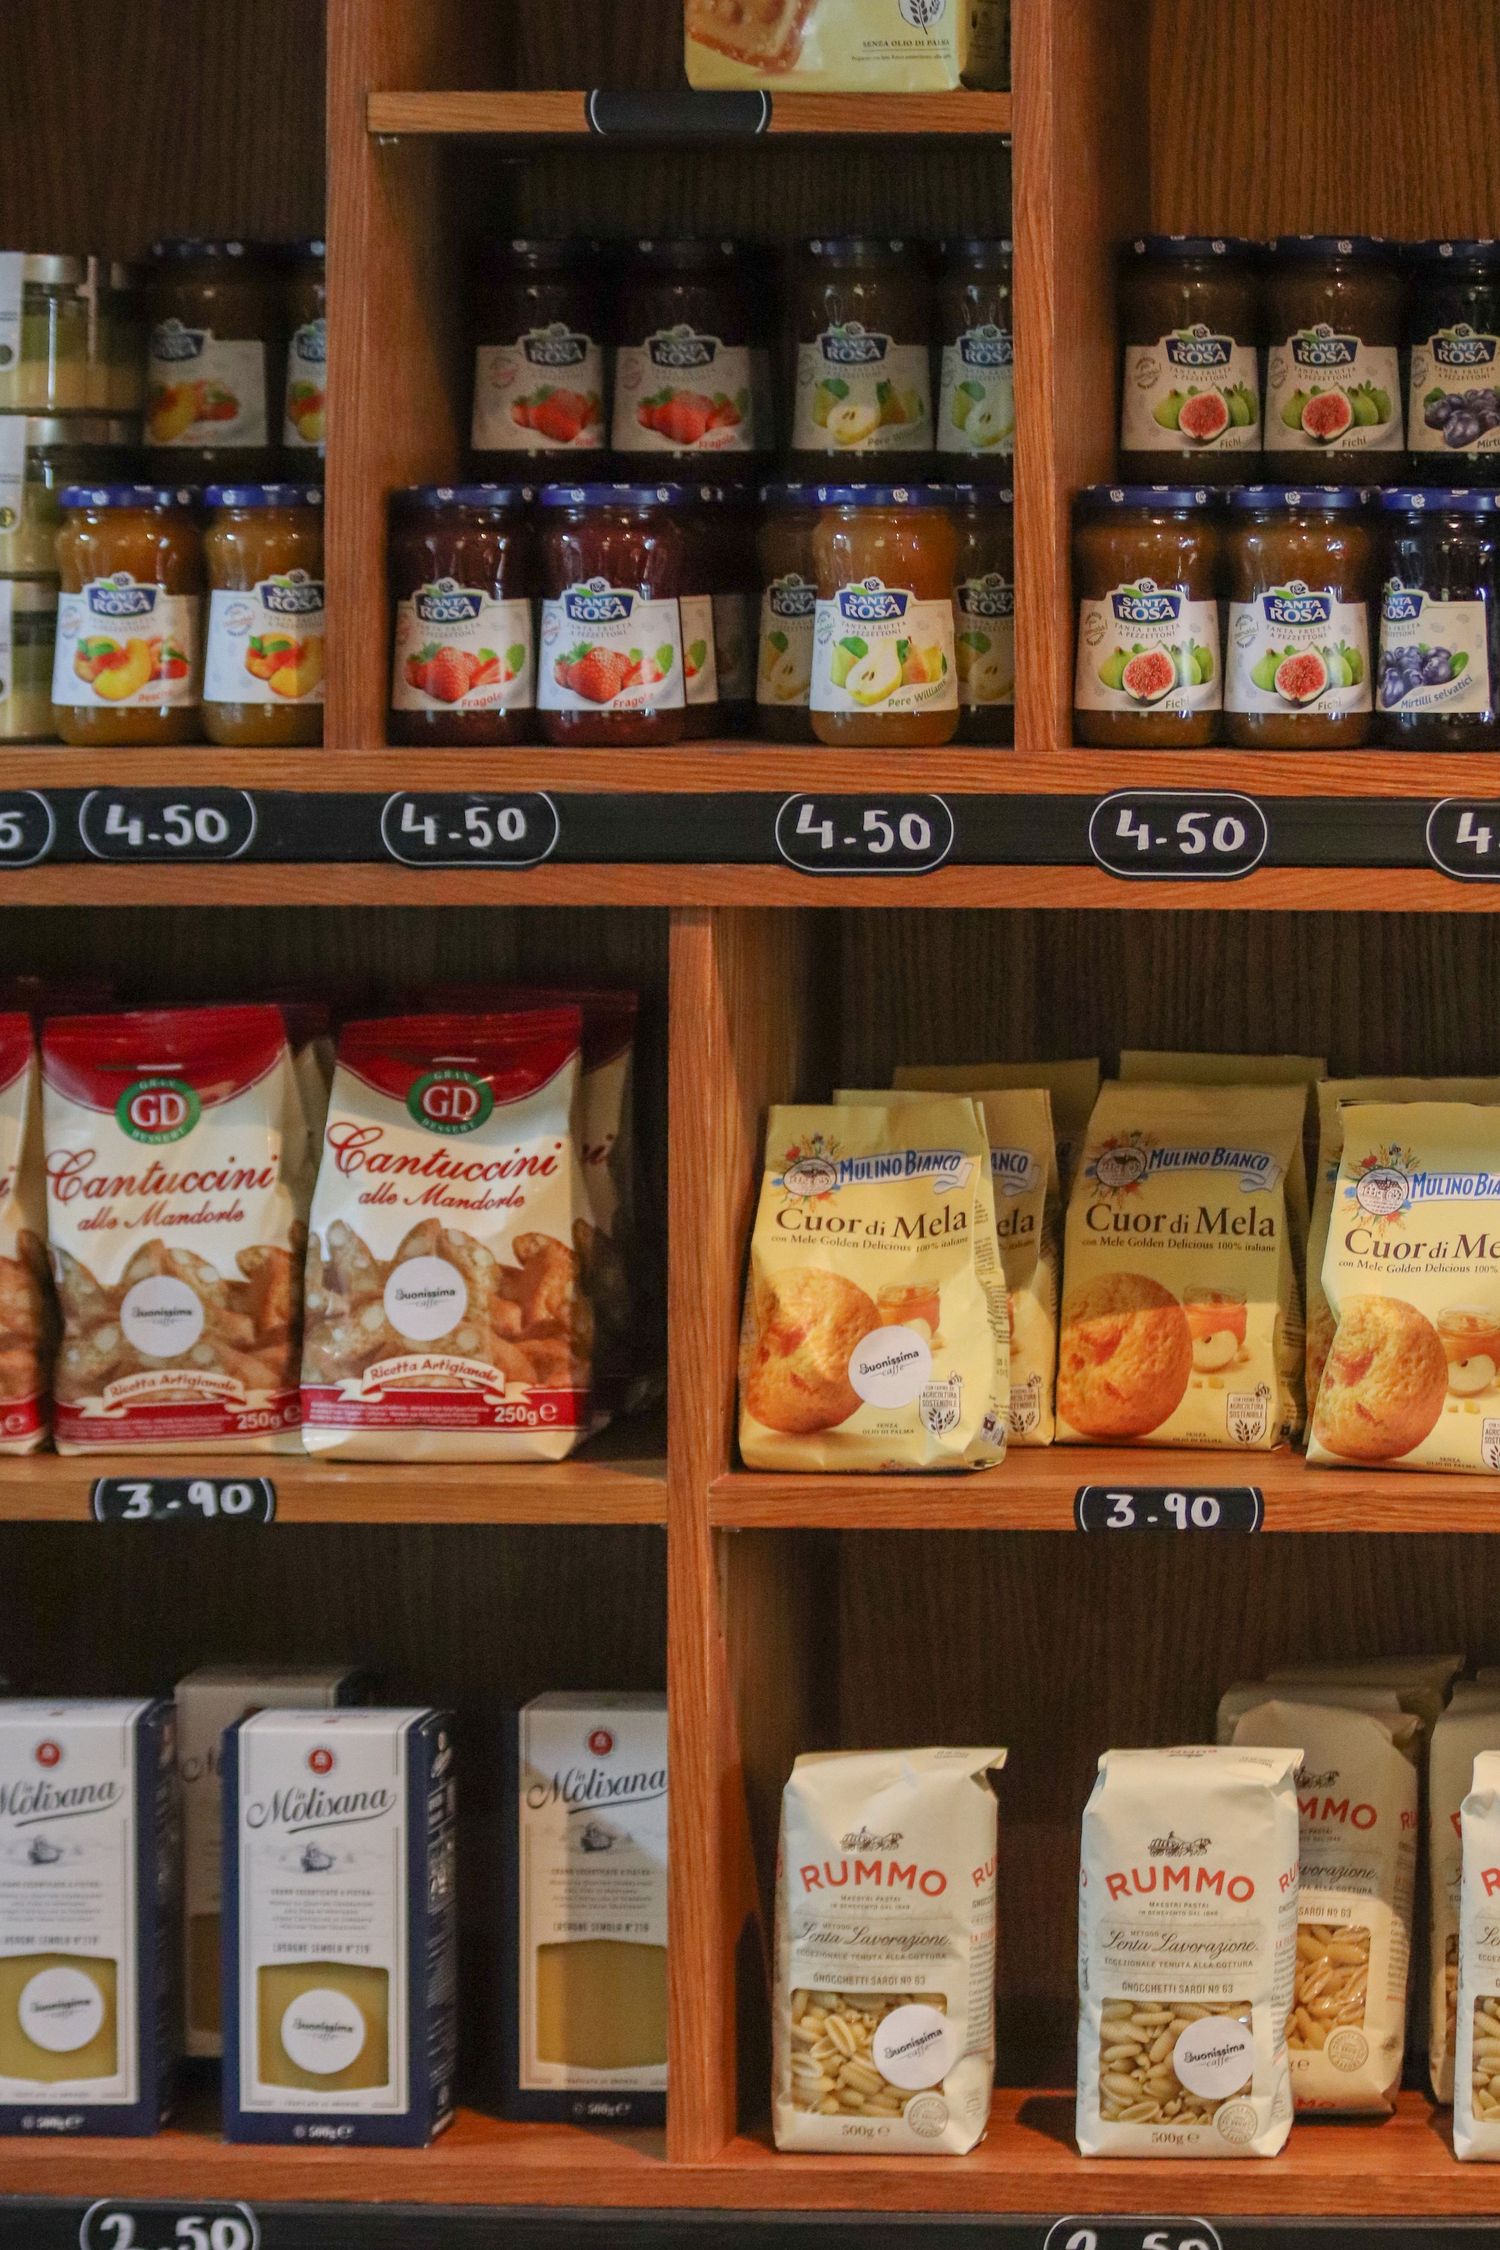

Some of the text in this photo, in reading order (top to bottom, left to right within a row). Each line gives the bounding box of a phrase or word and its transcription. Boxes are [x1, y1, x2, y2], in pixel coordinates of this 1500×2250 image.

[1177, 342, 1222, 351] SANTA
[1302, 341, 1347, 351] SANTA
[1441, 340, 1484, 350] SANTA
[826, 348, 882, 361] ROSA
[1172, 350, 1228, 364] ROSA
[1298, 350, 1351, 364] ROSA
[1438, 350, 1490, 364] ROSA
[1220, 436, 1242, 449] Fichi
[1342, 436, 1366, 448] Fichi
[98, 588, 144, 600] SANTA
[274, 587, 319, 598] SANTA
[848, 594, 896, 606] SANTA
[93, 598, 152, 614] ROSA
[266, 596, 322, 610] ROSA
[424, 596, 470, 608] SANTA
[574, 596, 621, 608] SANTA
[1122, 597, 1169, 607] SANTA
[1274, 599, 1322, 608] SANTA
[420, 604, 476, 620] ROSA
[570, 604, 628, 620] ROSA
[845, 604, 902, 619] ROSA
[1118, 606, 1176, 620] ROSA
[1270, 607, 1328, 622] ROSA
[872, 620, 906, 631] FRUTTA
[1114, 622, 1180, 632] TANTA FRUTTA
[461, 692, 504, 708] Fragole
[888, 679, 946, 708] Pere Williams
[1400, 674, 1473, 710] Mirtilli selvatici
[105, 804, 229, 846] 4.50
[402, 802, 527, 848] 4.50
[796, 804, 932, 854] 4.50
[1116, 810, 1246, 854] 4.50
[130, 1093, 186, 1127] GD
[422, 1086, 478, 1118] GD
[327, 1122, 562, 1182] Cantuccini
[1150, 1147, 1270, 1172] MULINO BIANCO
[840, 1150, 962, 1183] MULINO BIANCO
[46, 1150, 279, 1207] Cantuccini
[1410, 1172, 1474, 1199] MULINO
[358, 1182, 526, 1211] alle Mandorle
[78, 1198, 244, 1232] alle Mandorle
[776, 1204, 967, 1240] Cuor di Mela
[1086, 1204, 1276, 1238] Cuor di Mela
[790, 1234, 817, 1244] Mele
[820, 1236, 860, 1248] Golden
[862, 1238, 912, 1252] Delicious
[916, 1240, 940, 1253] 100%
[1100, 1236, 1125, 1247] Mele
[1128, 1238, 1164, 1248] Golden
[1168, 1239, 1214, 1250] Delicious
[1216, 1241, 1242, 1251] 100%
[1344, 1228, 1426, 1260] Cuor
[1428, 1241, 1448, 1258] di
[1338, 1260, 1498, 1274] con Mele Golden Delicious 100%
[395, 1287, 456, 1300] Buonissima
[370, 1359, 498, 1382] Ricetta Artigianale
[859, 1350, 920, 1375] Buonissima
[237, 1412, 281, 1430] 250g
[495, 1406, 538, 1426] 250g
[117, 1481, 255, 1518] 3.90
[1106, 1492, 1220, 1530] 3.90
[526, 1767, 667, 1810] Molisana
[246, 1786, 393, 1830] Molisana
[800, 1860, 947, 1897] RUMMO
[1104, 1865, 1255, 1903] RUMMO
[795, 1921, 951, 1951] Lenta Lavorazione
[1102, 1930, 1257, 1960] Lenta Lavorazione
[850, 1953, 882, 1961] TENUTA
[886, 1952, 905, 1960] ALLA
[908, 1952, 947, 1960] COTTURA
[1104, 1958, 1156, 1968] ECCEZIONALE
[1216, 1960, 1254, 1968] COTTURA
[813, 1972, 897, 1985] GNOCCHETTI SARDI
[1122, 1982, 1234, 1994] GNOCCHETTI SARDI 63
[884, 2028, 944, 2060] Buonissima
[1184, 2044, 1245, 2064] Buonissima
[842, 2125, 874, 2138] 500g
[1152, 2132, 1184, 2144] 500g
